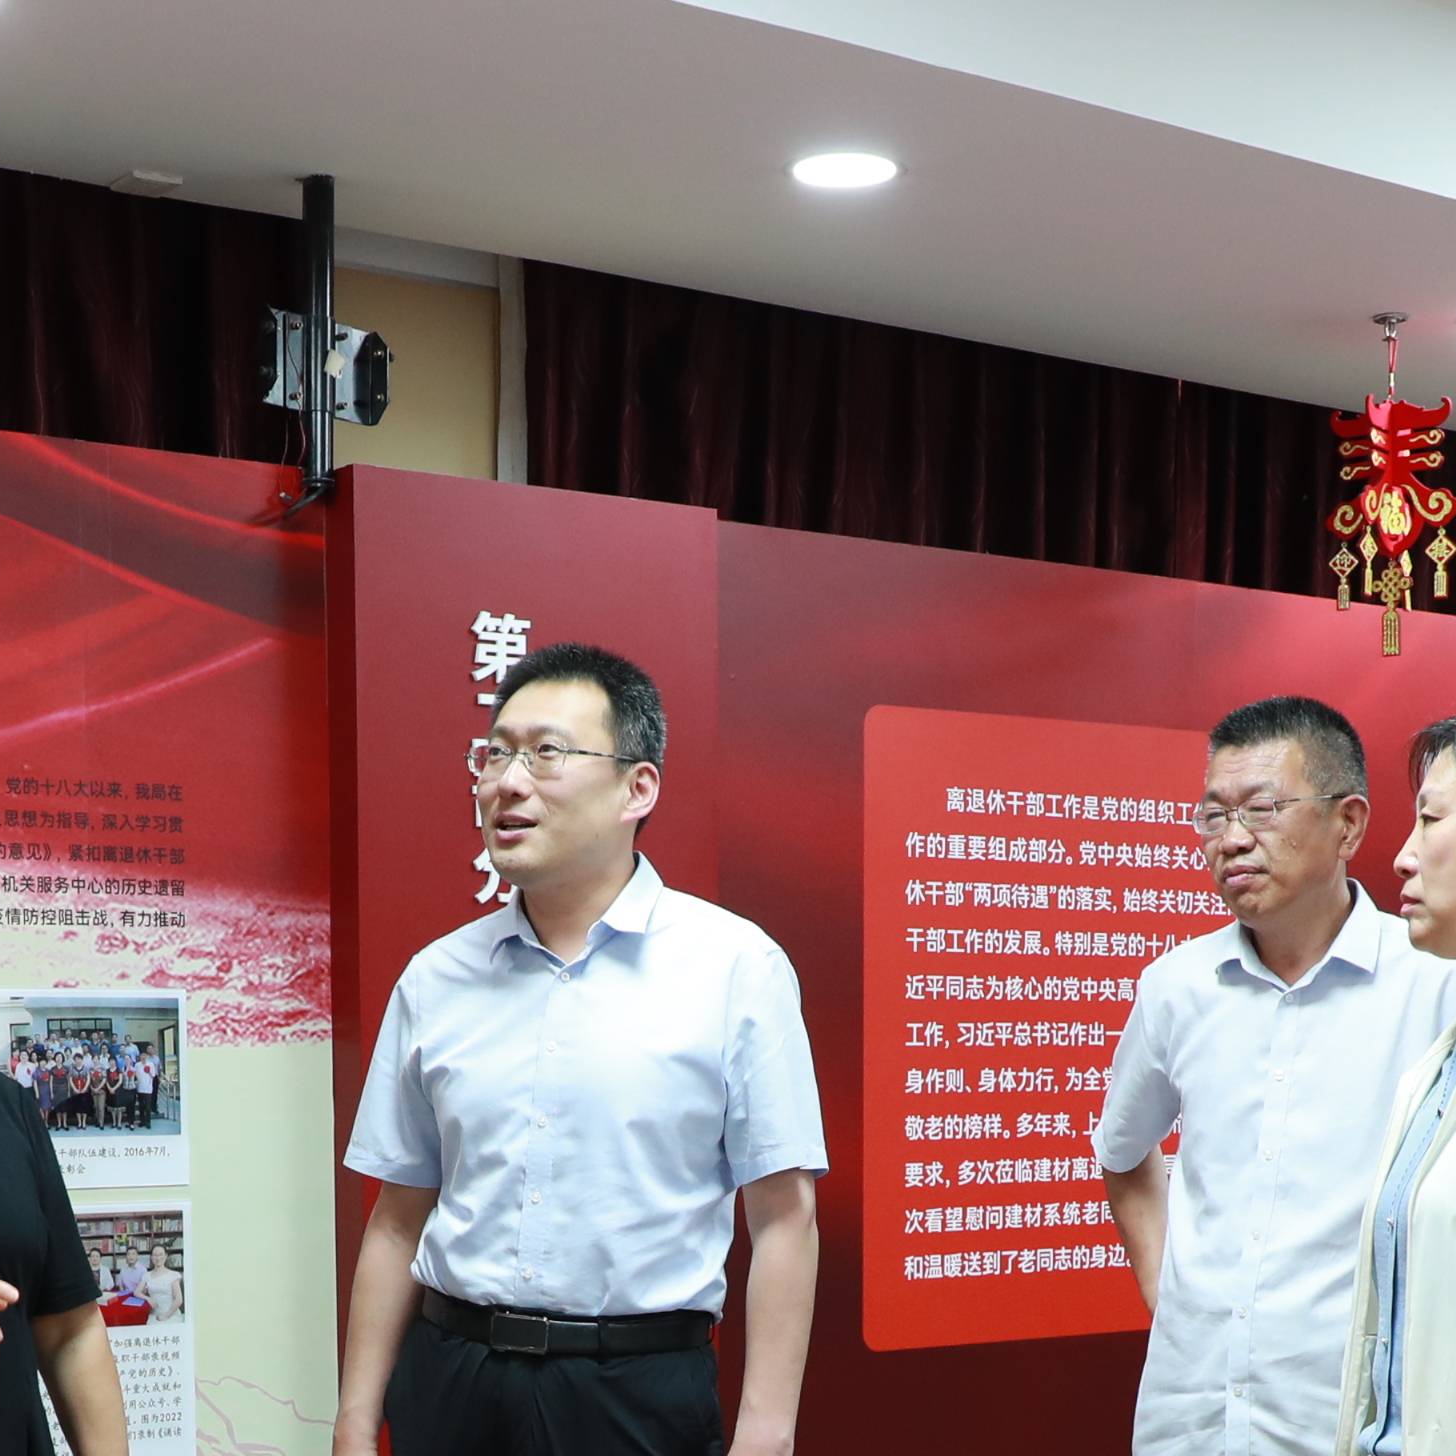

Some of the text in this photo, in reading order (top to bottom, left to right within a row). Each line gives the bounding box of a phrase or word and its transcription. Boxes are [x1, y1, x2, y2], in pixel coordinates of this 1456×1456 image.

[905, 831, 1210, 871] 作的重要组成部分。党中央始终关心
[905, 879, 1232, 916] 休干部“两项待遇”的落实，始终关切关注
[905, 974, 1138, 1002] 近平同志为核心的党中央高
[54, 1145, 171, 1158] 干部队伍建设，2016年7月，
